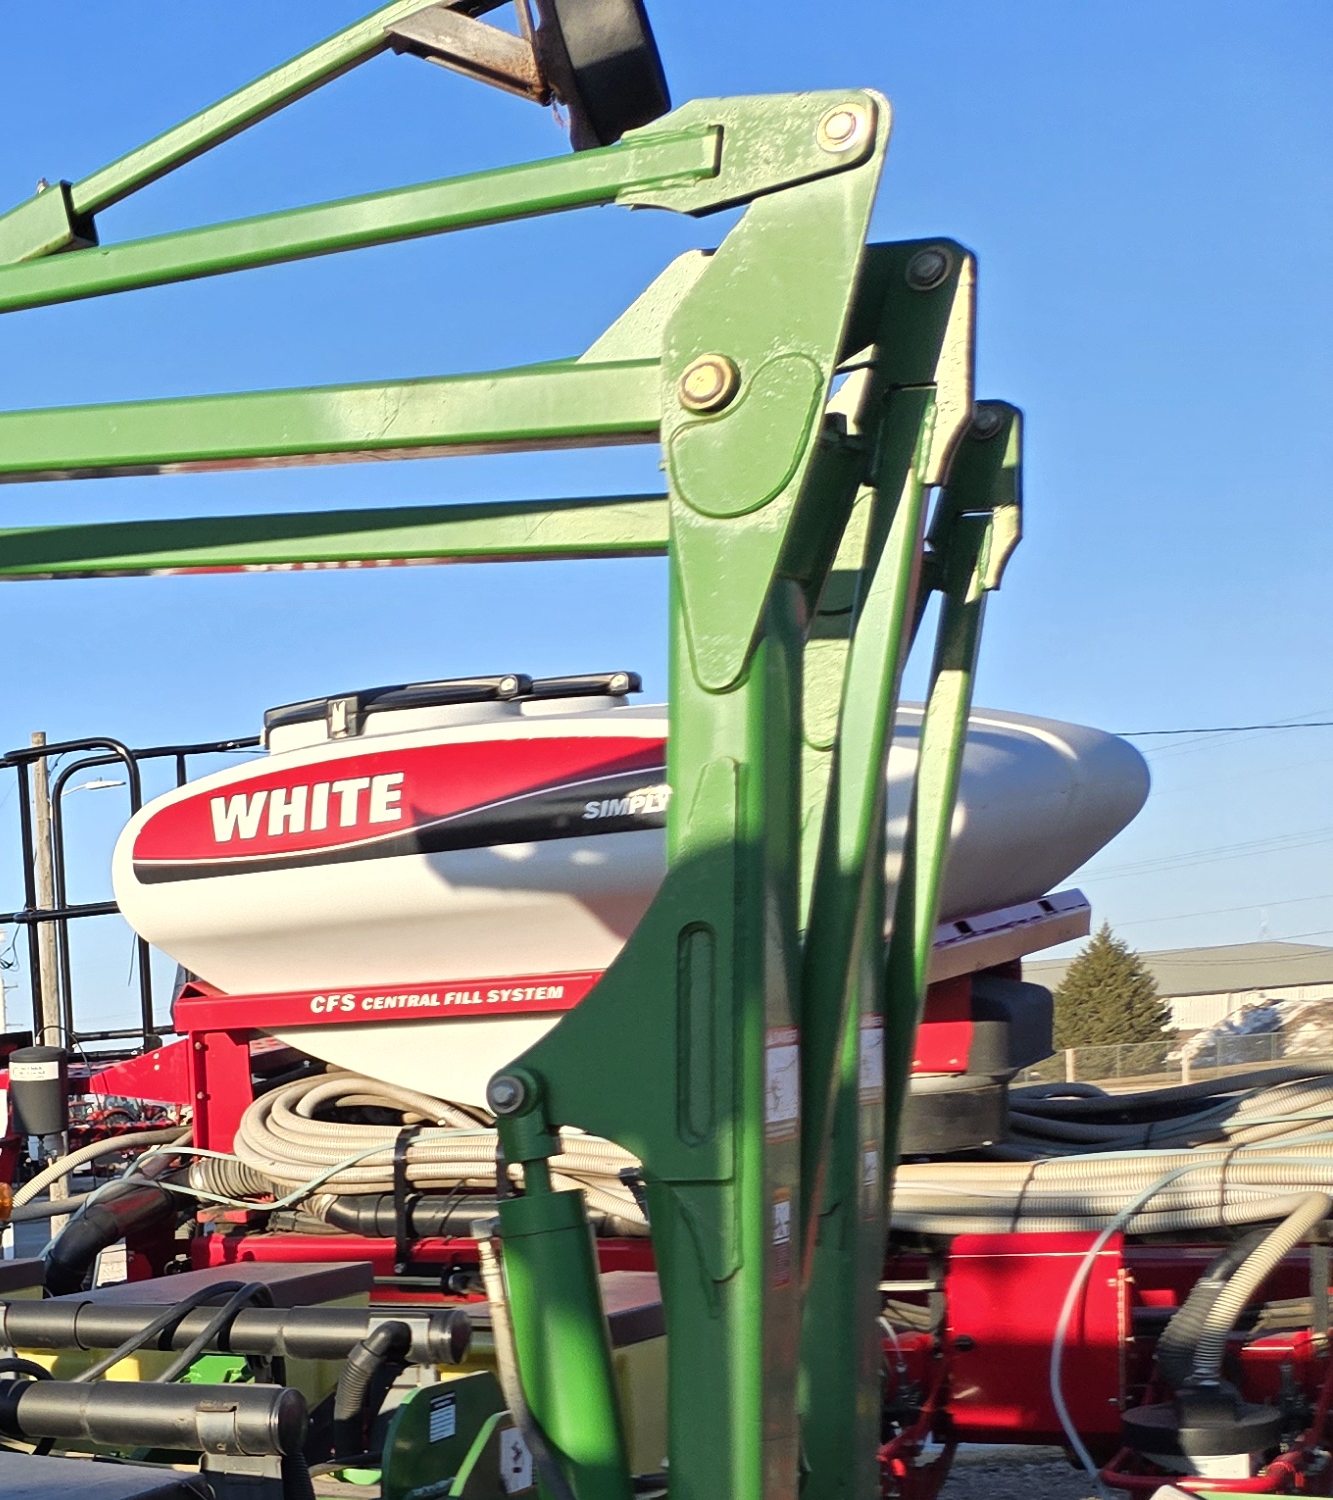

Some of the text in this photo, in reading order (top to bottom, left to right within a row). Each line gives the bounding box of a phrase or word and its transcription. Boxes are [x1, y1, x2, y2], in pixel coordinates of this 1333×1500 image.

[210, 772, 404, 843] WHITE
[582, 792, 669, 820] SIMPLY
[310, 986, 564, 1013] CFS CENTRAL FILL SYSTEM
